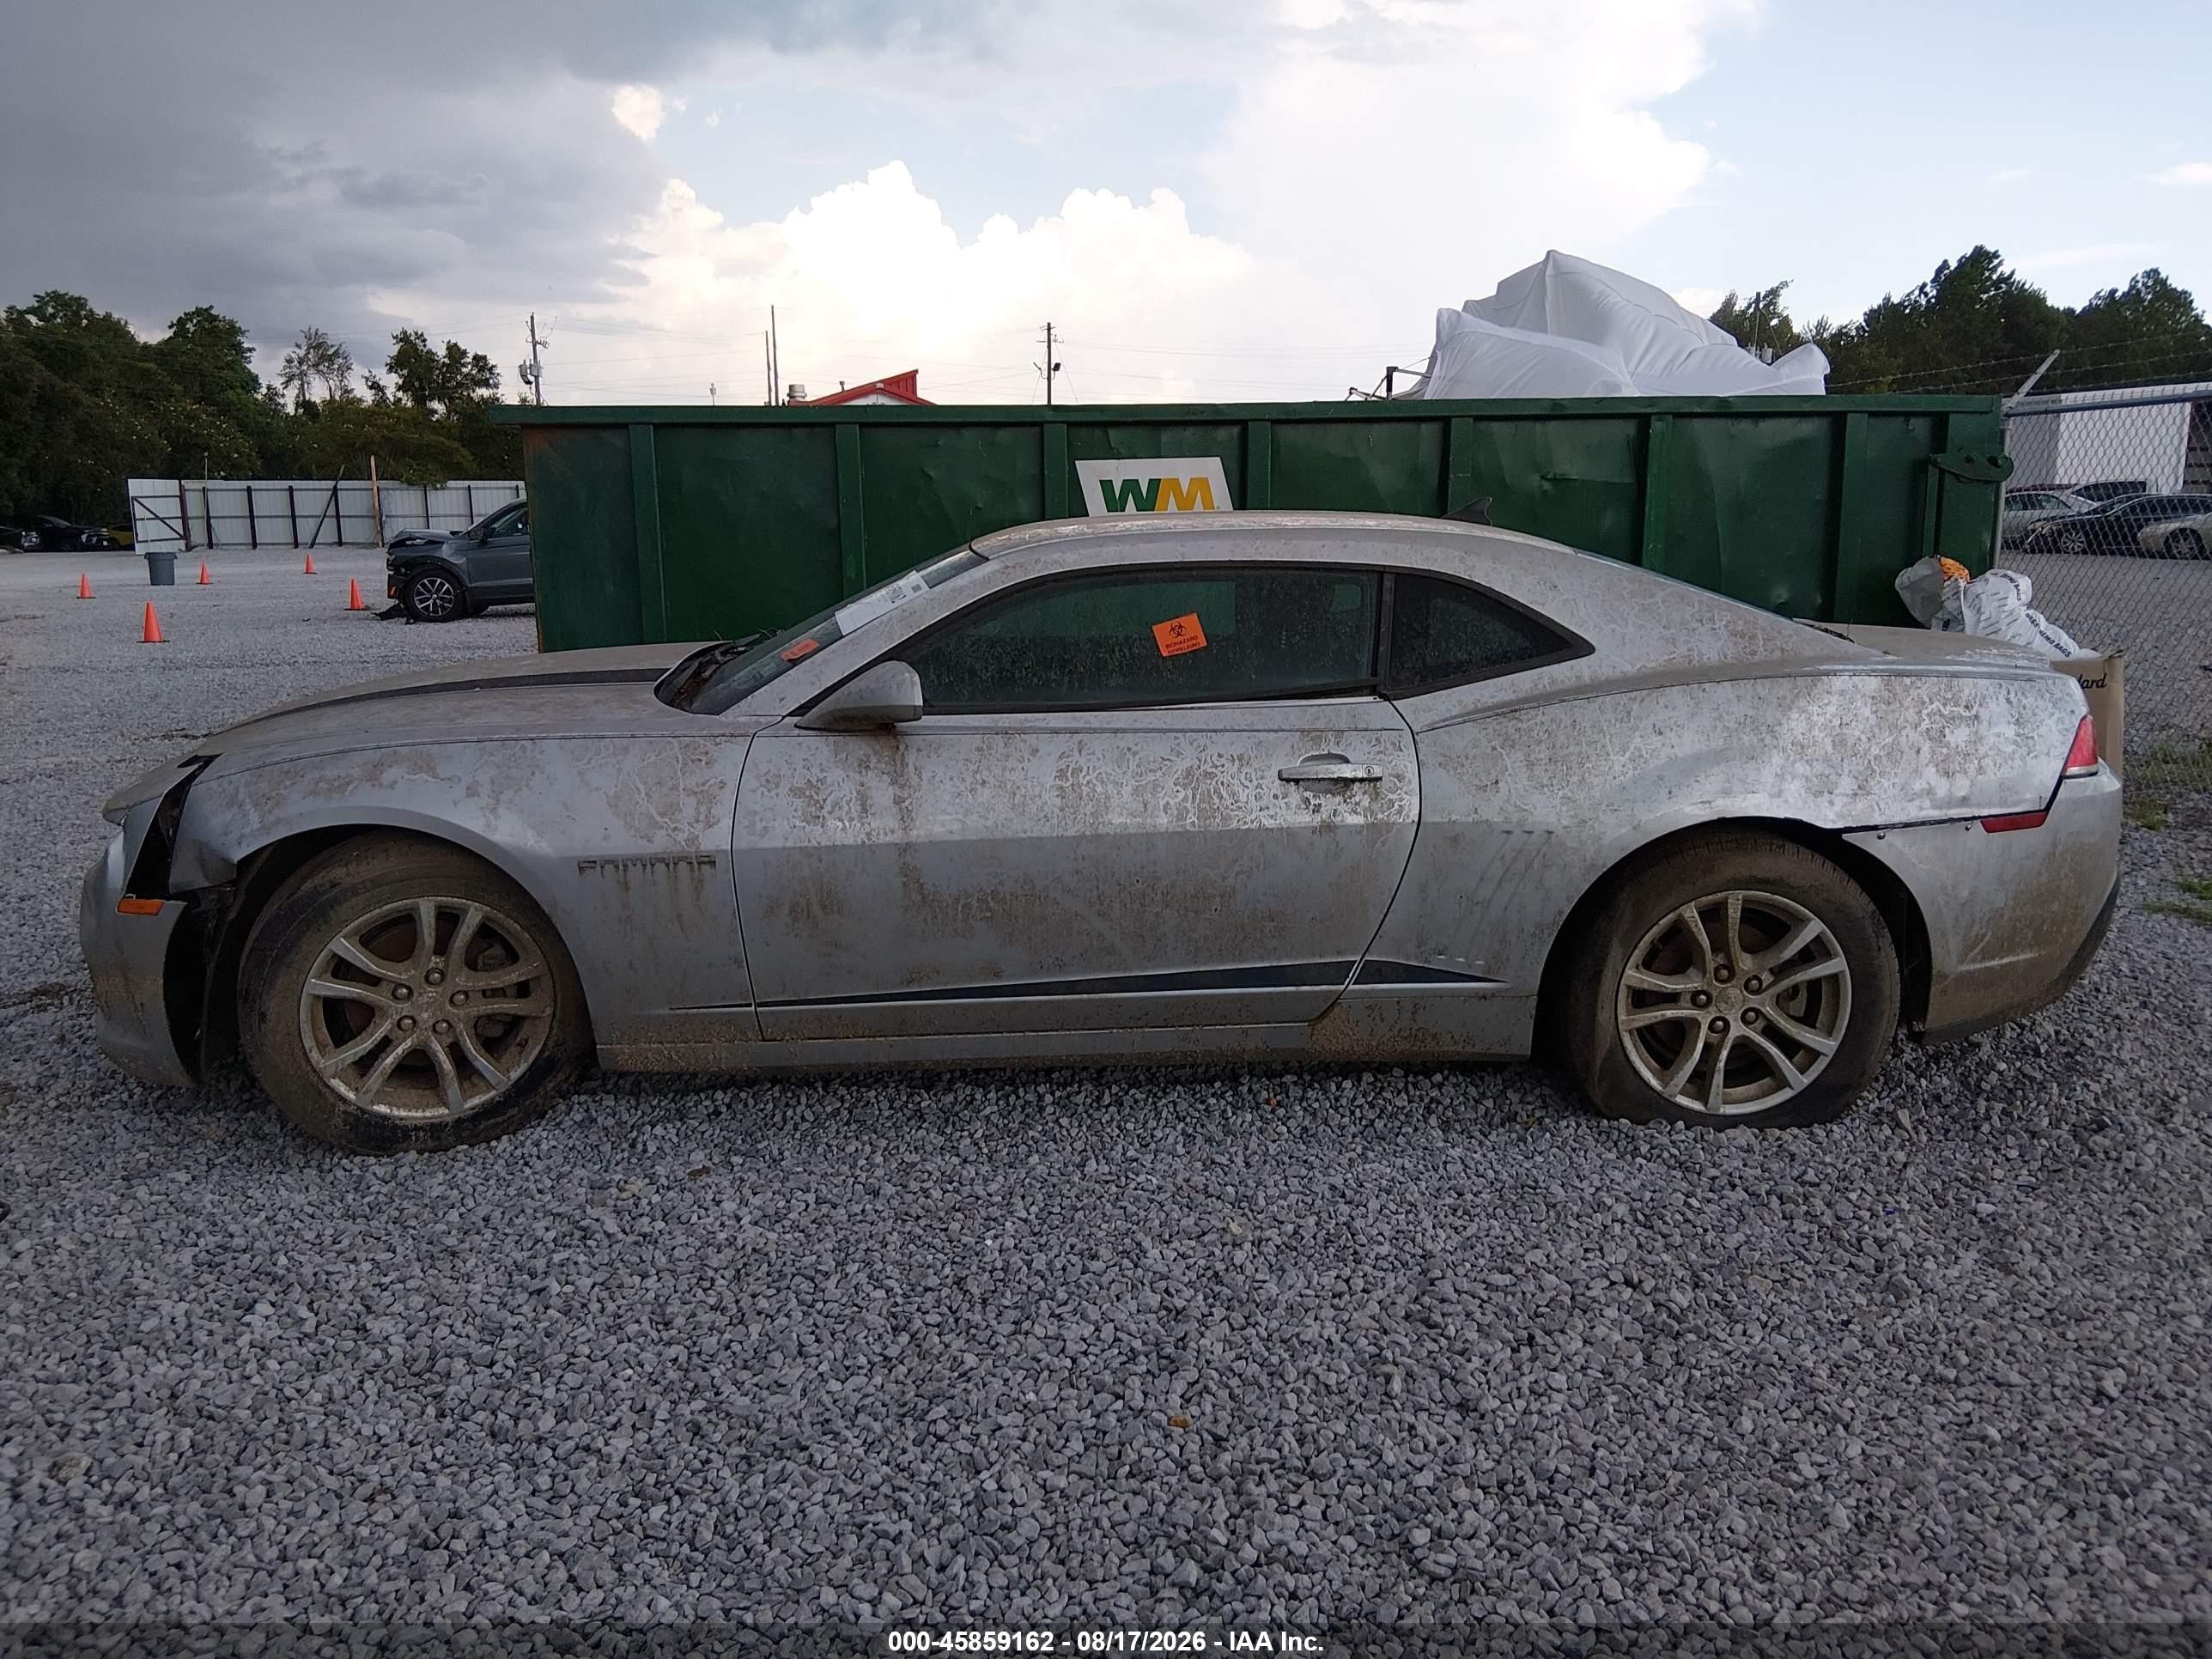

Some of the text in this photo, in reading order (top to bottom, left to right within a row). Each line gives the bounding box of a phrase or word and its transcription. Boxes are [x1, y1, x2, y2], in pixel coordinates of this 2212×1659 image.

[1098, 477, 1216, 513] WM
[1164, 635, 1199, 649] BIOHAZARD
[2053, 642, 2072, 658] BAGS
